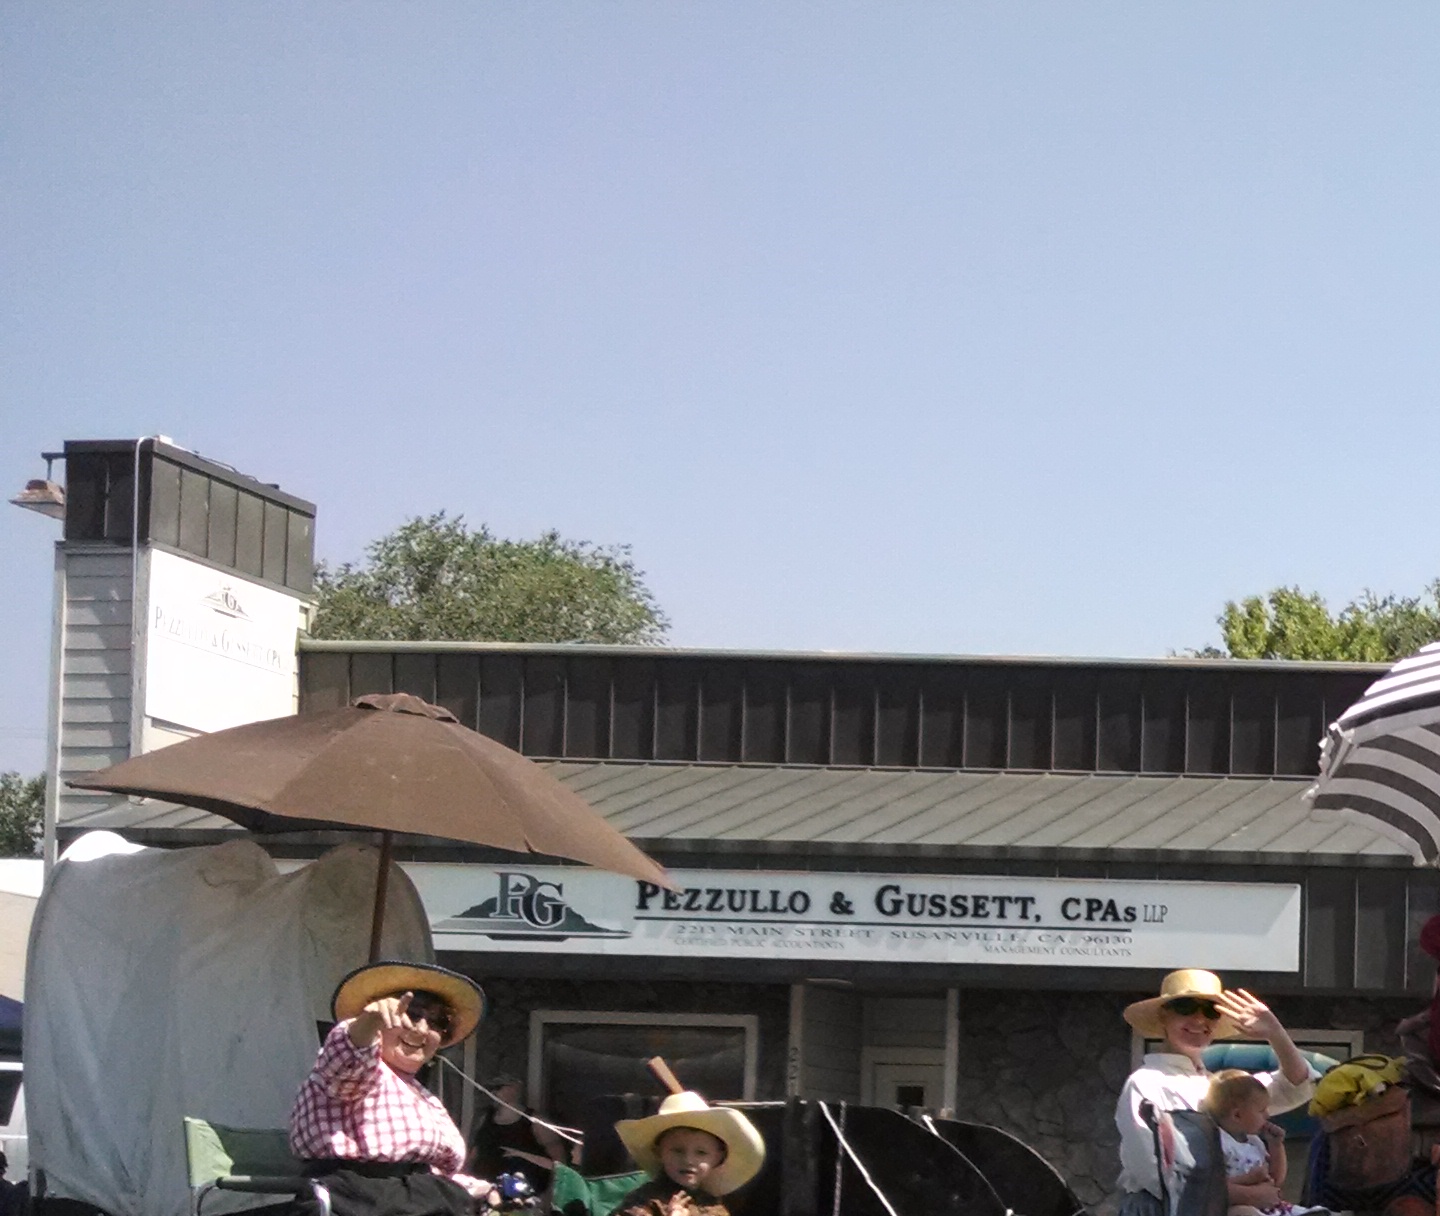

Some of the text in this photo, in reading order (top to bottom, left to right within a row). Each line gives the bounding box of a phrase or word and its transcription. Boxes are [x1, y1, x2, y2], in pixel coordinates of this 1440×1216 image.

[489, 872, 567, 929] PG
[635, 880, 1168, 923] PEZZULLO & GUSSETT, CPAs LLP
[677, 925, 716, 935] 2213
[726, 926, 784, 937] MAIN
[798, 928, 875, 939] STREET
[1081, 935, 1133, 945] 96130
[984, 945, 1056, 955] MANAGEMENT
